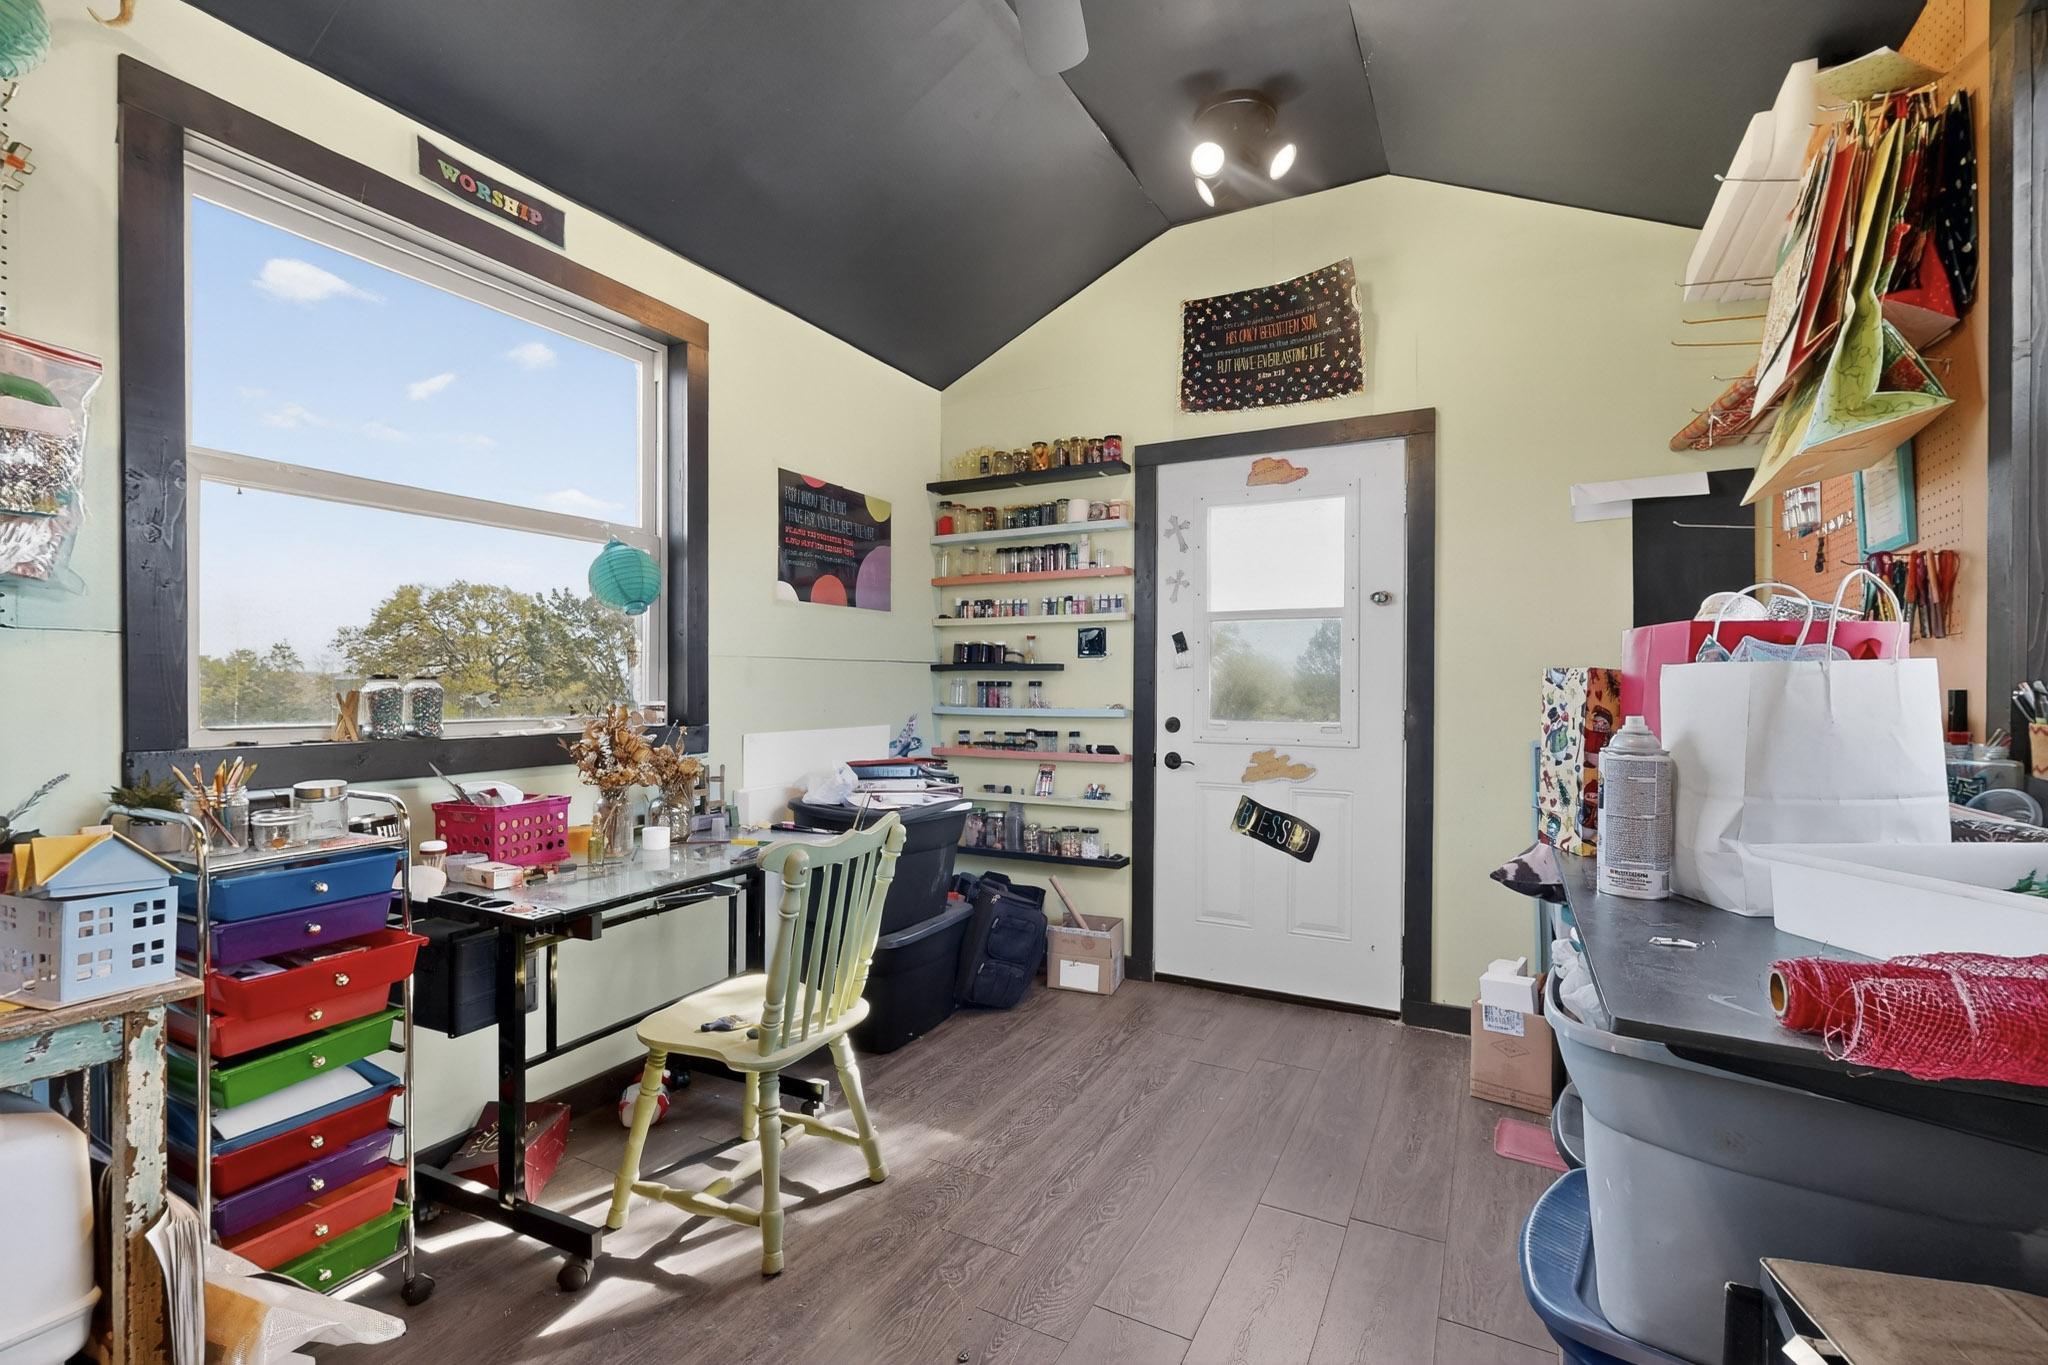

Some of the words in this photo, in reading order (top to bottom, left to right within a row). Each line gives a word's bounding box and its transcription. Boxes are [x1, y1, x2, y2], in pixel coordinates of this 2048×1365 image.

[437, 159, 543, 226] WORSHIP
[1217, 359, 1232, 374] BUT
[1234, 355, 1255, 371] HAVE
[1257, 346, 1308, 368] EVERLASTING
[1309, 342, 1326, 360] LIFE
